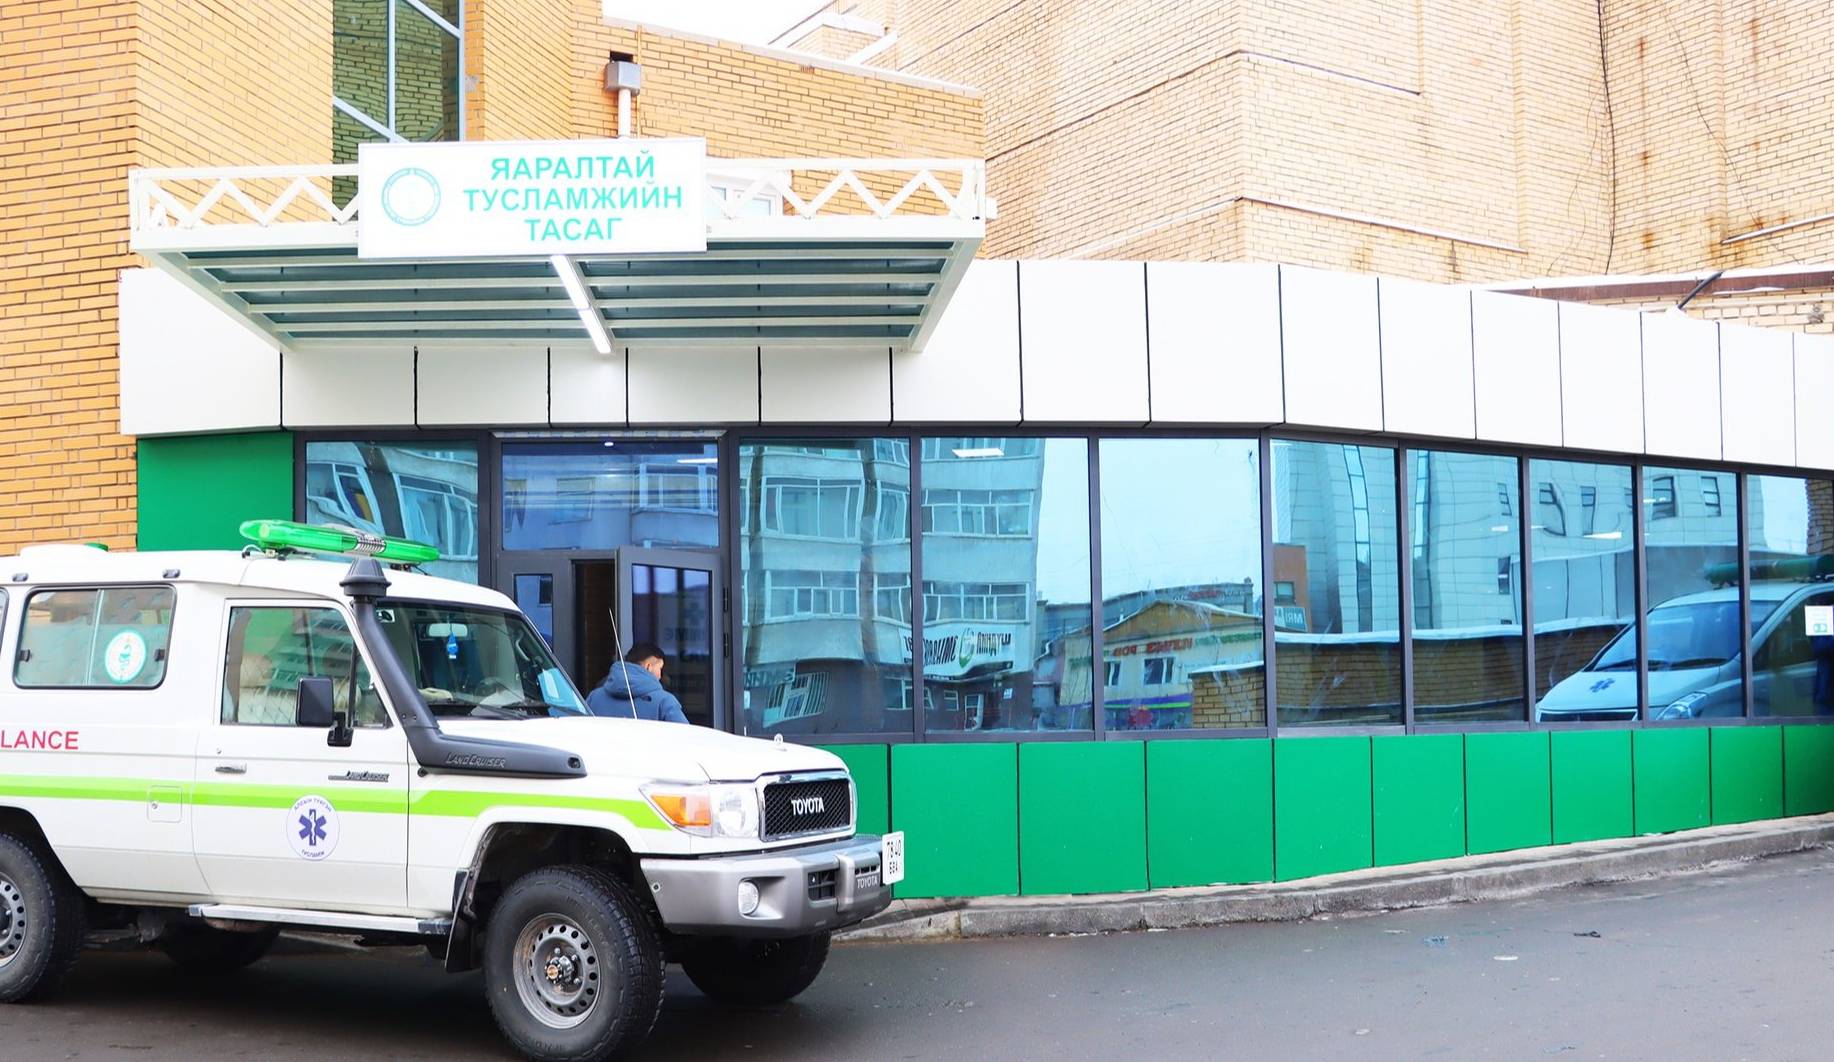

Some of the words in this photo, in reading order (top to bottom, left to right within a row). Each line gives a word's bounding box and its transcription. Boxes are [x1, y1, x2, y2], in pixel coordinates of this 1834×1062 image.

[491, 149, 655, 180] ЯАРАЛТАЙ
[463, 181, 682, 211] ТУСЛАМЖИЙН
[525, 217, 622, 241] ТАСАГ
[1, 730, 79, 750] LANCE
[791, 797, 825, 816] TOYOTA
[857, 877, 879, 888] TOYOTA
